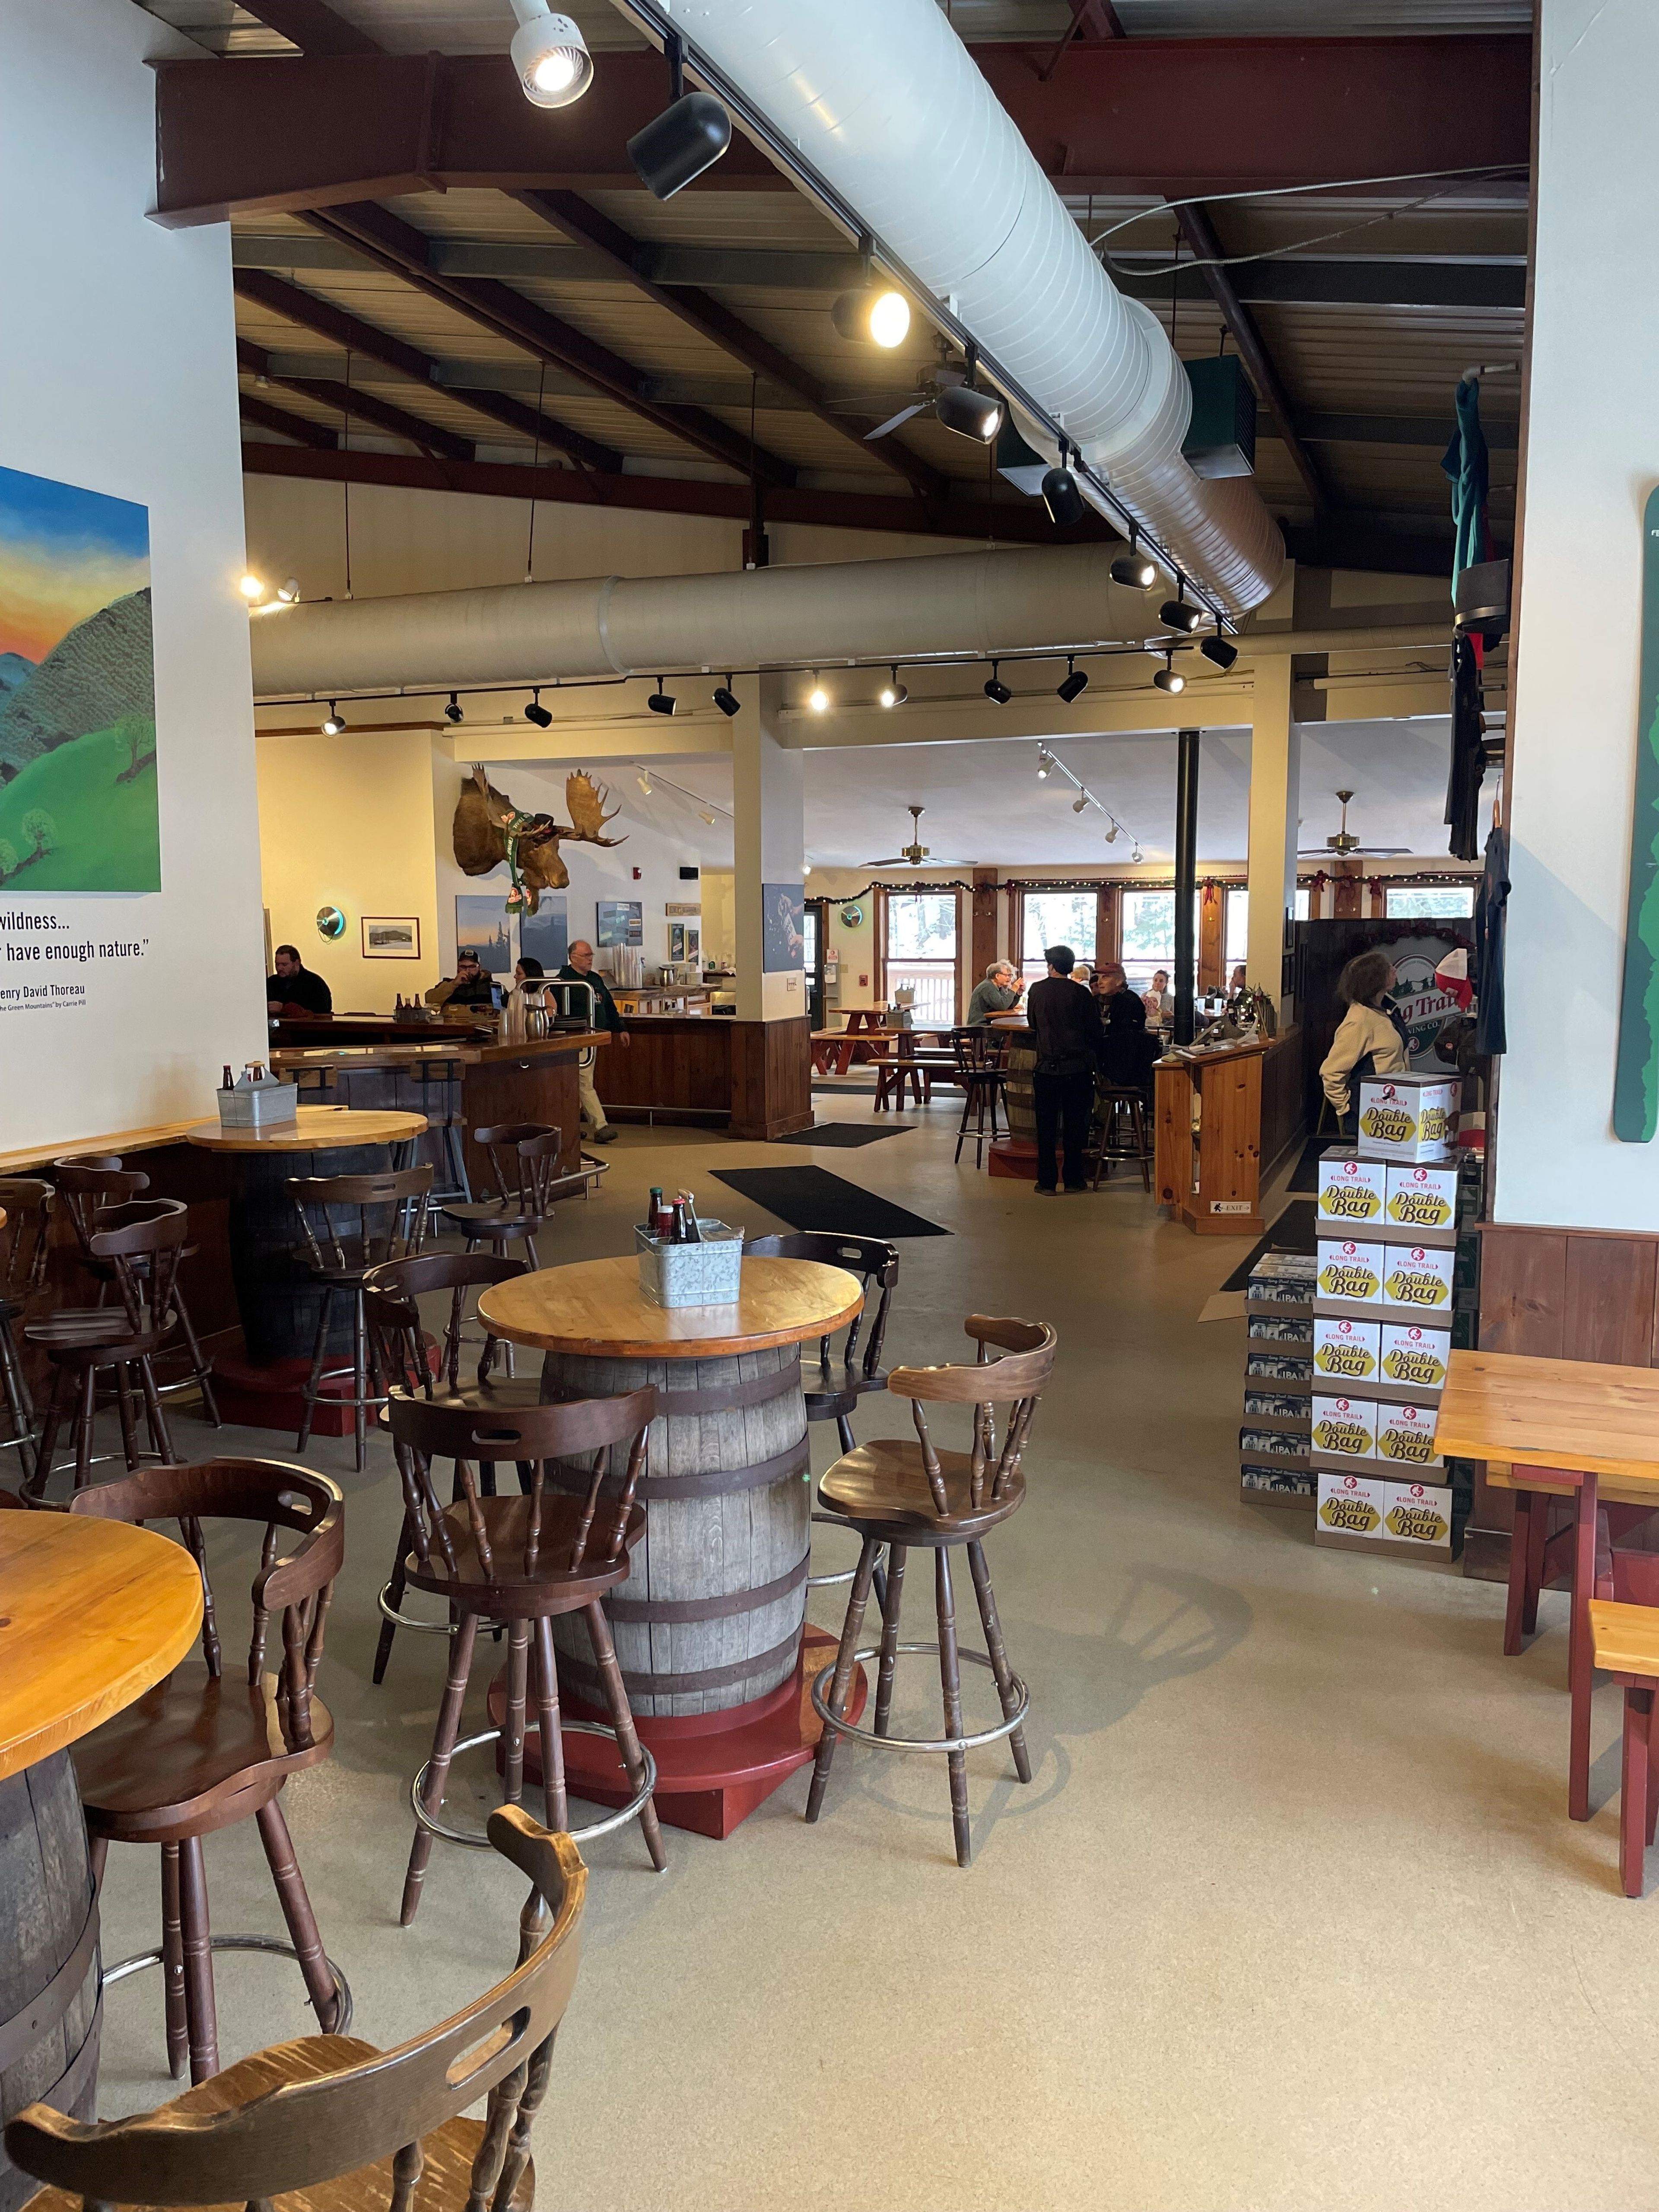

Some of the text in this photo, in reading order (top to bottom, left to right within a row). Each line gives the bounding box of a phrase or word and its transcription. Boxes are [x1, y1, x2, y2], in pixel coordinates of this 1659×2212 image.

[6, 939, 149, 962] have enough nature.”
[0, 985, 85, 1001] enry David Thoreau
[1416, 995, 1455, 1017] Trai
[1367, 1107, 1411, 1123] Double
[1421, 1106, 1446, 1124] Double
[1369, 1120, 1406, 1141] Bag
[1422, 1121, 1443, 1141] Bag
[1327, 1185, 1376, 1200] Double
[1395, 1192, 1446, 1207] Double
[1330, 1197, 1370, 1218] Bag
[1398, 1205, 1440, 1225] Bag
[1325, 1264, 1374, 1279] Double
[1392, 1270, 1443, 1286] Double
[1328, 1276, 1369, 1297] Bag
[1395, 1283, 1438, 1305] Bag
[1322, 1343, 1370, 1358] Double
[1390, 1349, 1440, 1366] Double
[1325, 1355, 1365, 1376] Bag
[1393, 1362, 1435, 1384] Bag
[1319, 1420, 1368, 1436] Double
[1385, 1429, 1434, 1445] Double
[1323, 1433, 1363, 1454] Bag
[1389, 1442, 1430, 1463] Bag
[1327, 1497, 1375, 1514] Double
[1392, 1506, 1443, 1522] Double
[1329, 1510, 1370, 1531] Bag
[1396, 1519, 1437, 1540] Bag
